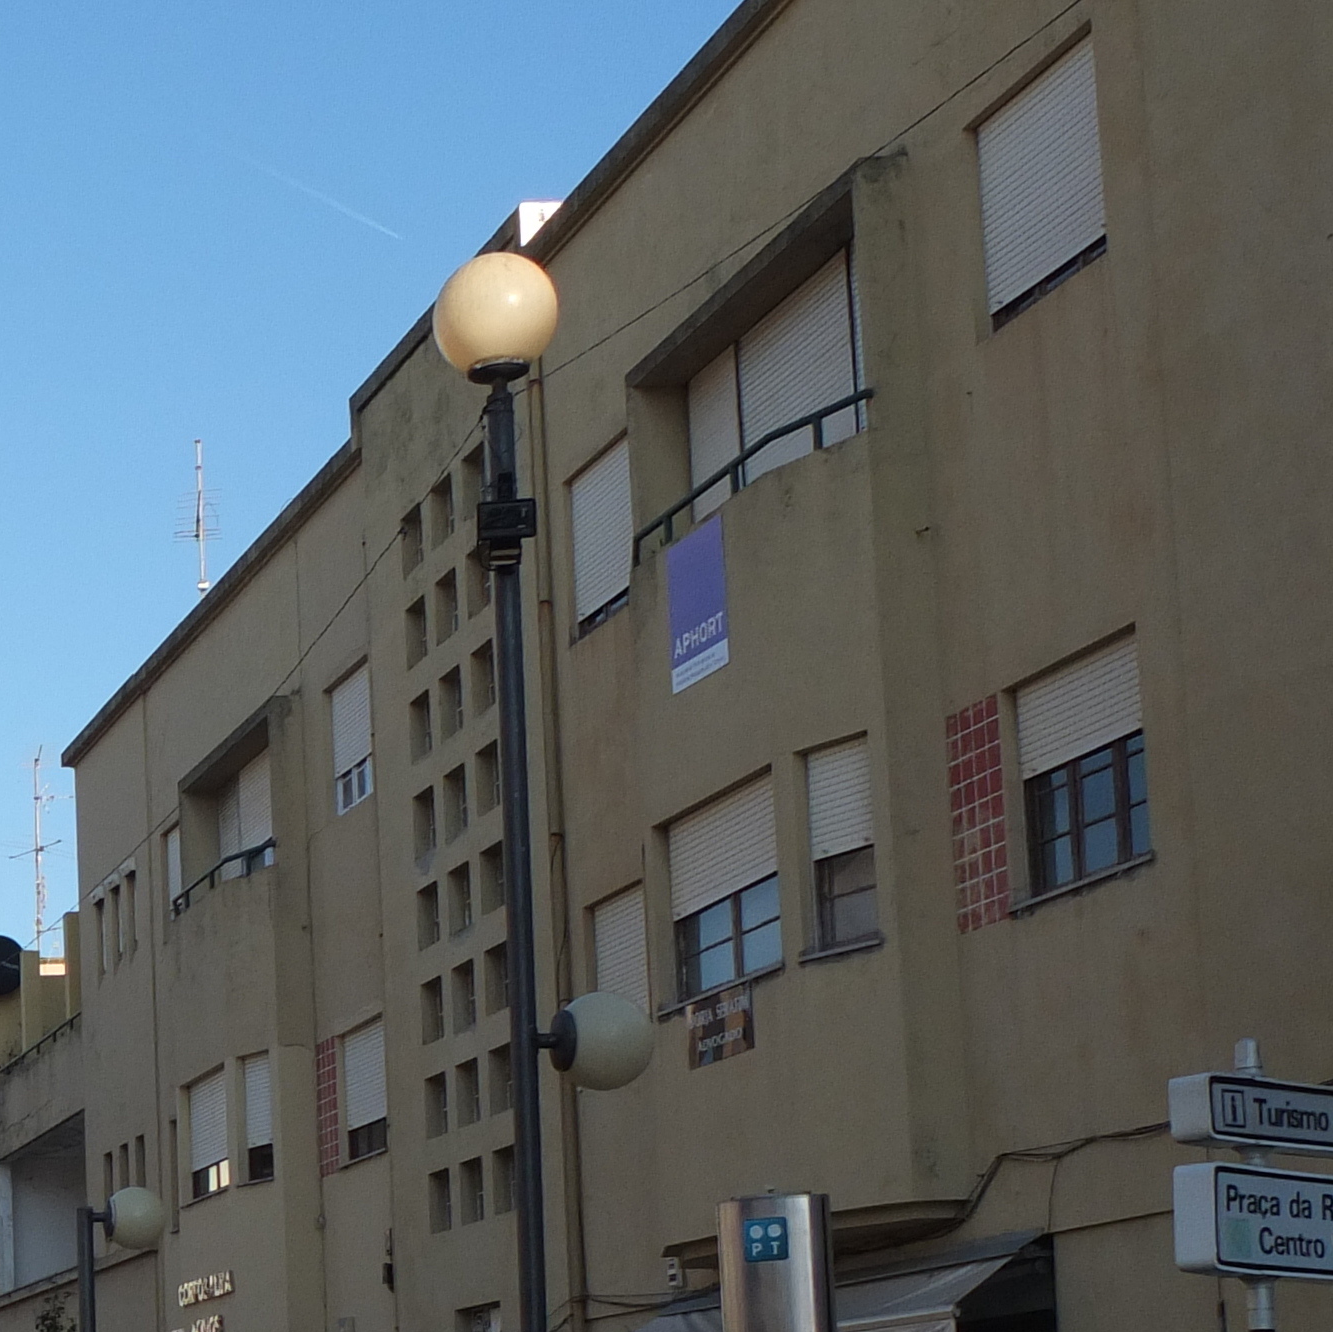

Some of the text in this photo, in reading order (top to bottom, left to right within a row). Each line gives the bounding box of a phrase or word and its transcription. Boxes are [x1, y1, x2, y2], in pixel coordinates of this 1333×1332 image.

[674, 612, 724, 659] APHORT
[1253, 1098, 1329, 1131] Turismo
[1226, 1184, 1281, 1220] Praça
[1289, 1191, 1313, 1219] da
[752, 1241, 781, 1256] PT
[1259, 1227, 1325, 1258] Centro
